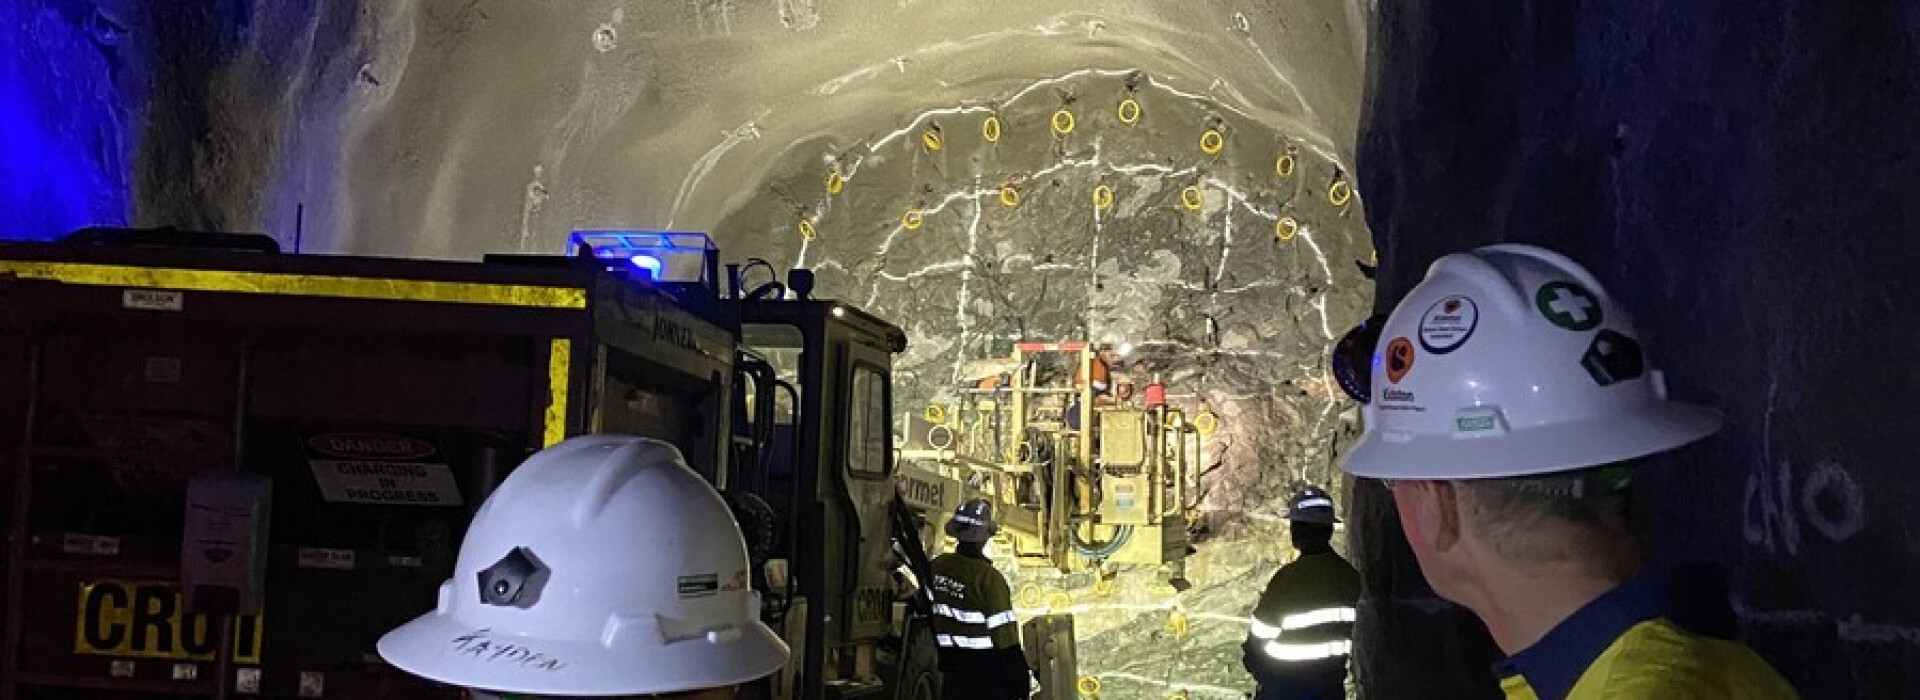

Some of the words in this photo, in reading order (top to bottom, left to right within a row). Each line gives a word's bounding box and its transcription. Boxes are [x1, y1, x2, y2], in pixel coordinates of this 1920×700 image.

[328, 438, 411, 453] DANGER
[337, 463, 427, 477] CHARGING
[379, 478, 397, 488] IN
